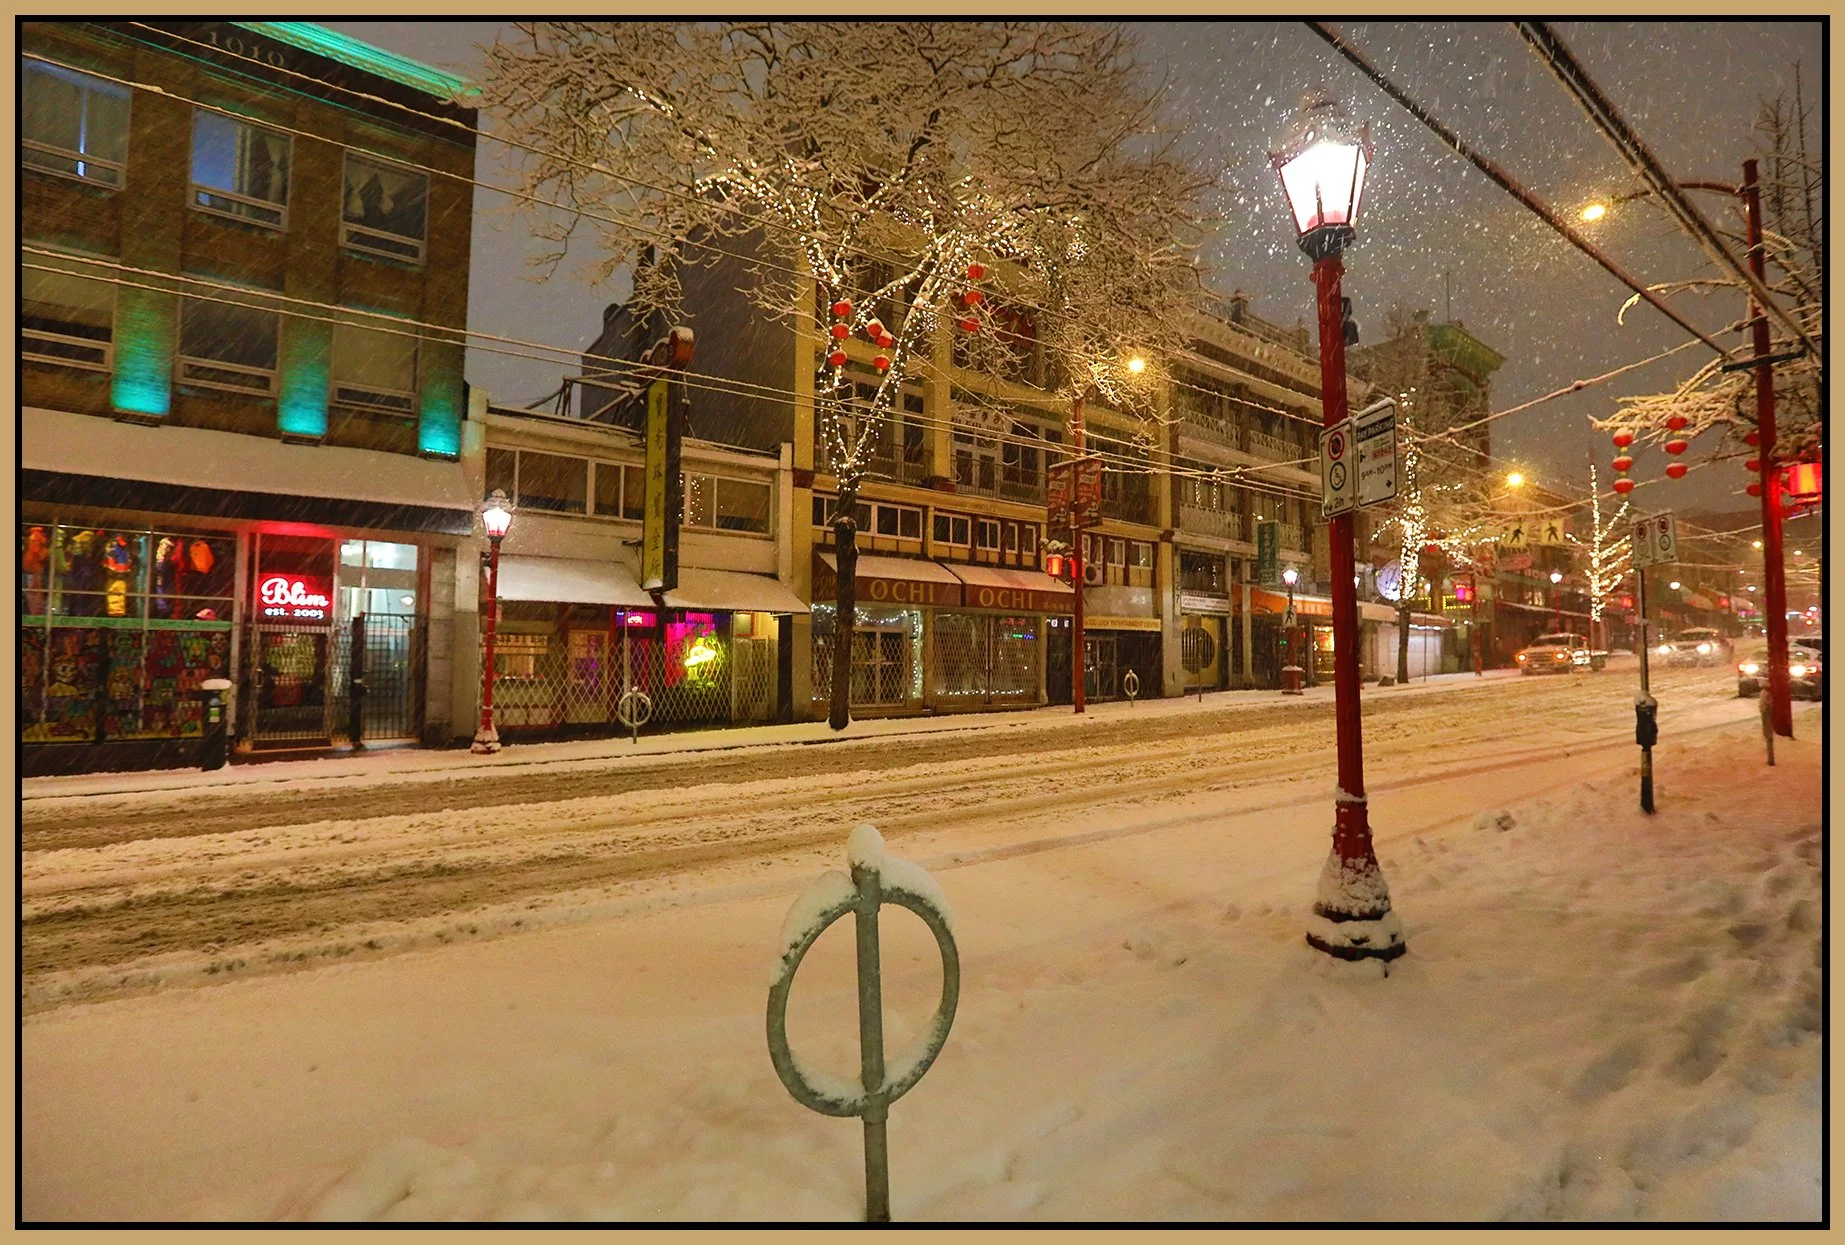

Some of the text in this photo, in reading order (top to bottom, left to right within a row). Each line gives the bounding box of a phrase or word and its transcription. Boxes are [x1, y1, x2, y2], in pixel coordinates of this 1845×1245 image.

[1368, 418, 1394, 436] PARKING
[261, 577, 329, 606] Blim
[870, 579, 935, 603] OCHI
[978, 588, 1033, 609] OCHI
[264, 607, 289, 616] est.
